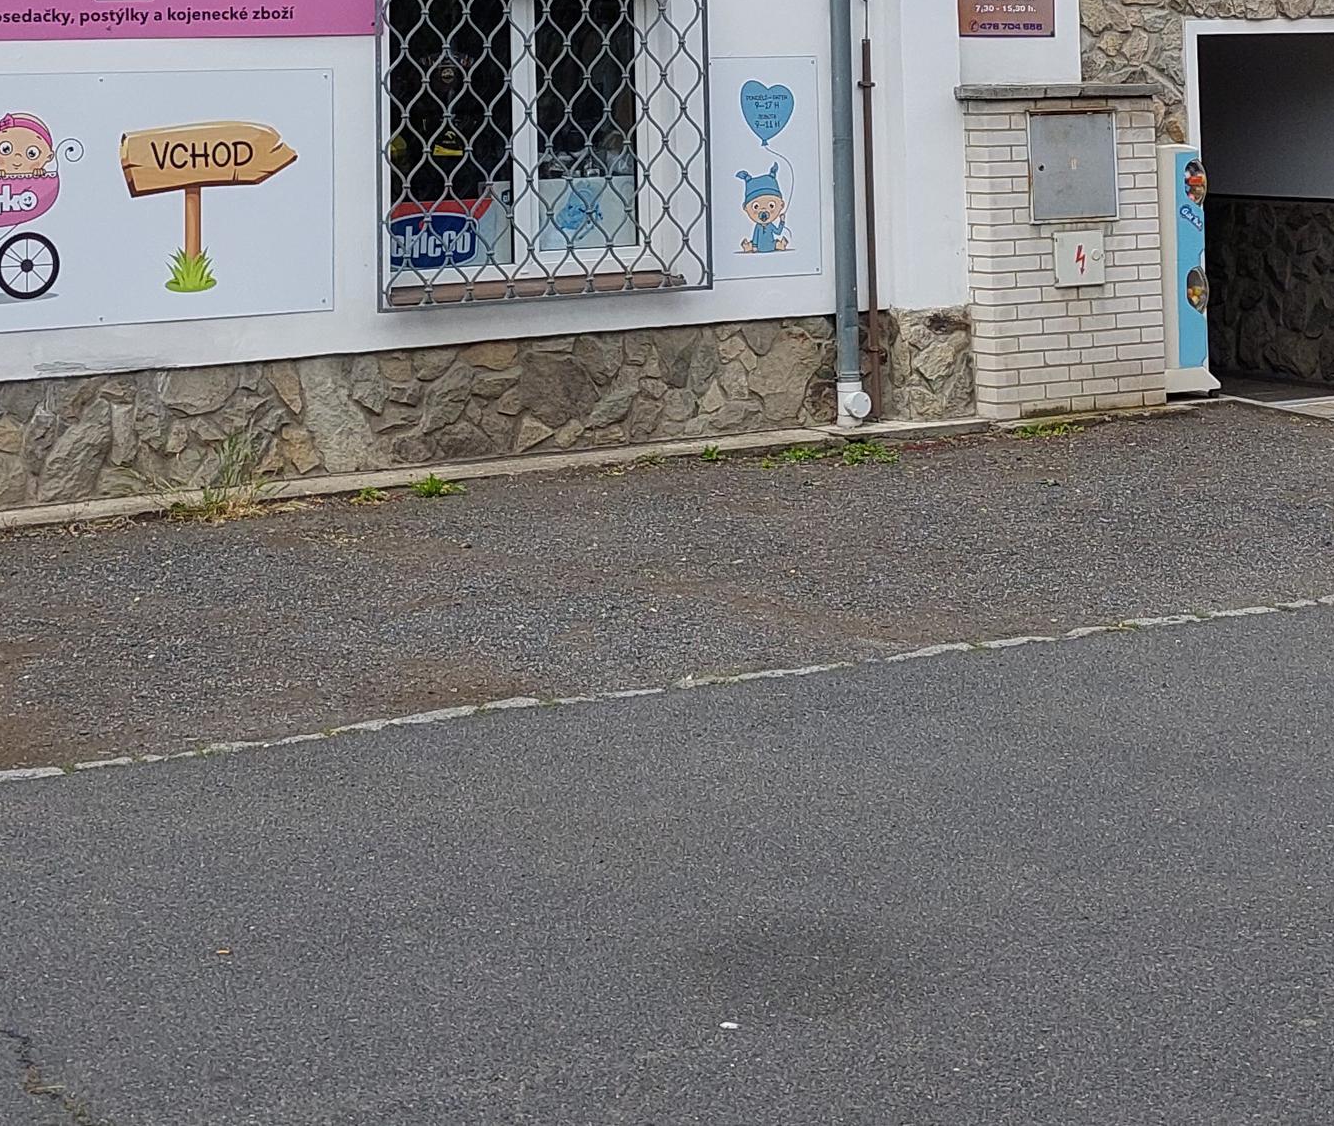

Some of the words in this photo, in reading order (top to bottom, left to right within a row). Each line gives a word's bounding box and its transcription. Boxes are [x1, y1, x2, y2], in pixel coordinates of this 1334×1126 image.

[79, 7, 149, 26] postýlky
[153, 11, 162, 21] a
[167, 6, 248, 24] kojenecké
[252, 5, 294, 20] zboží
[151, 141, 253, 170] VCHOD
